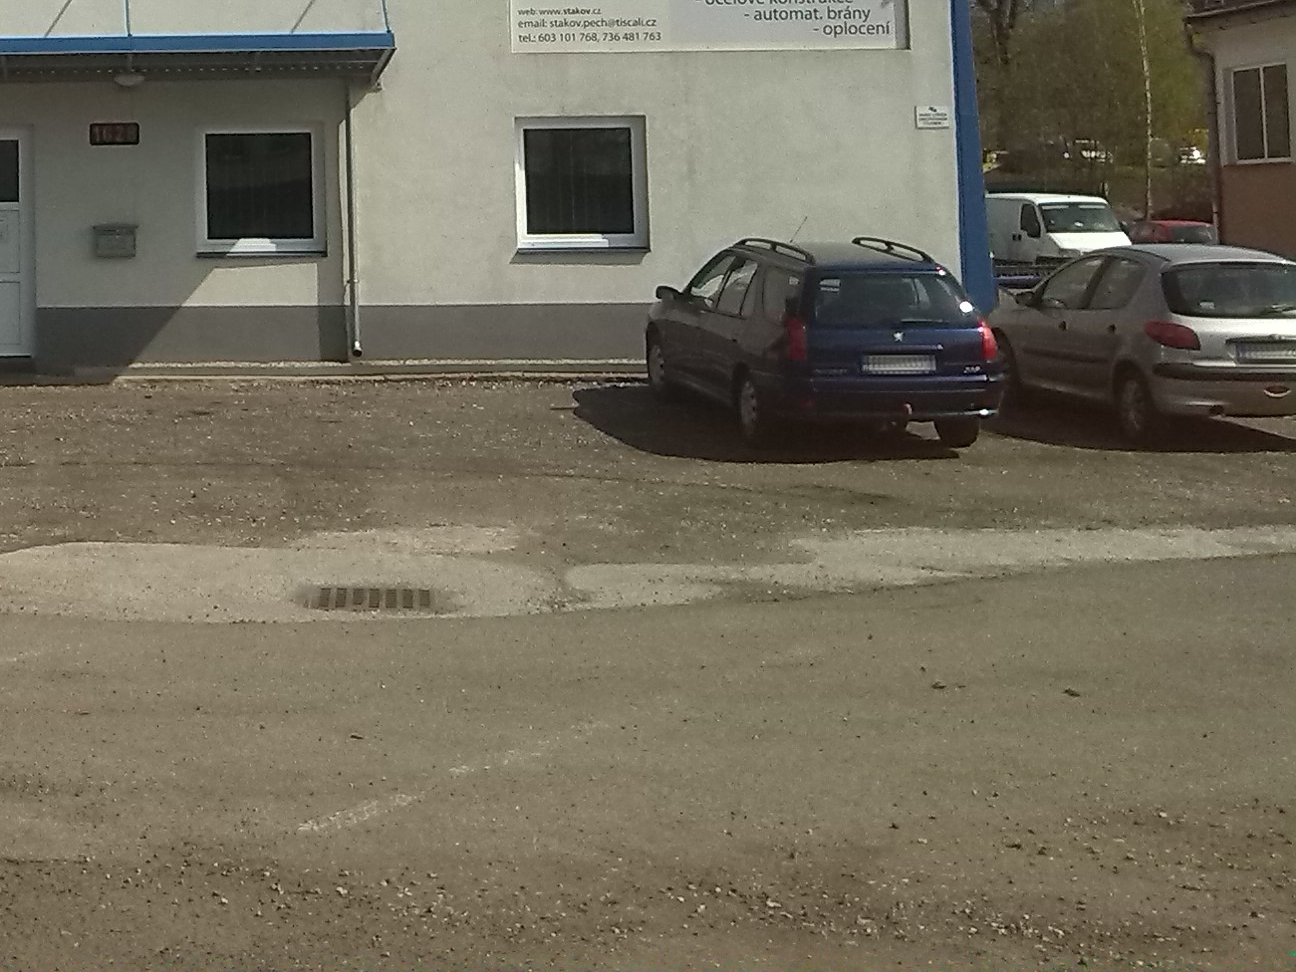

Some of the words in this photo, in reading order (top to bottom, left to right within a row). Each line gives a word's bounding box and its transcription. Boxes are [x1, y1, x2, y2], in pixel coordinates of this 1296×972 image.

[539, 7, 602, 16] www.stakov.cz
[753, 7, 823, 21] automat.
[827, 6, 871, 23] brány
[517, 19, 547, 29] email:
[822, 21, 890, 38] oplocení
[538, 33, 556, 43] 603
[559, 33, 576, 42] 101
[602, 32, 621, 42] 736
[622, 32, 640, 42] 481
[643, 31, 662, 42] 763
